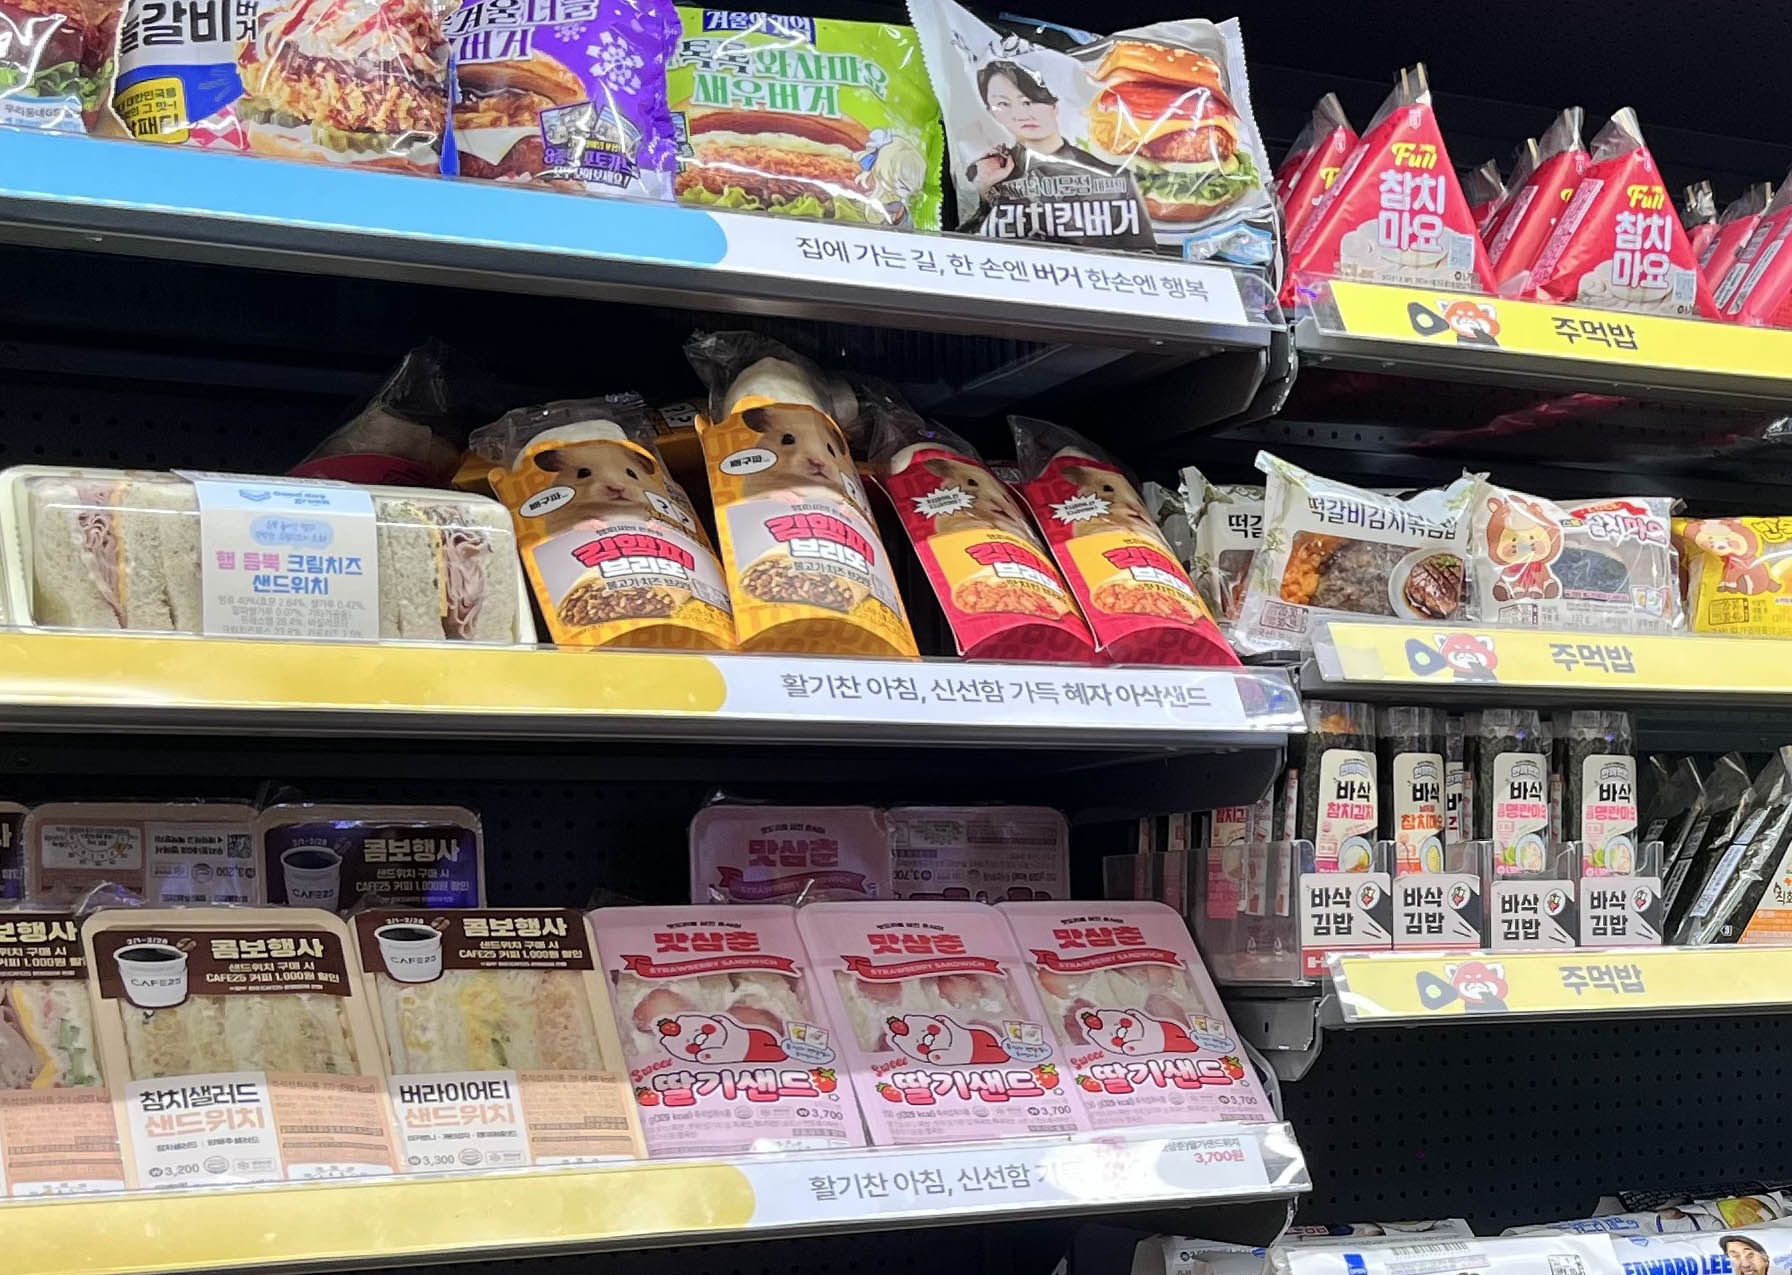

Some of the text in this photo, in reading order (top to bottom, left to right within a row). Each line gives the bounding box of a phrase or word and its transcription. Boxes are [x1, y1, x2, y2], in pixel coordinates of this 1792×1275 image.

[693, 73, 840, 117] 새우버거
[1379, 169, 1445, 216] 참치
[1377, 212, 1443, 254] 마요
[796, 236, 1209, 302] 집에 가는 길, 한 손엔 버거 한손엔 행복
[1552, 316, 1638, 352] 주먹밥
[216, 551, 234, 571] 햄
[286, 553, 363, 576] 크림치즈
[252, 574, 329, 595] 샌드위치
[1549, 642, 1637, 675] 주먹밥
[780, 673, 1211, 709] 활기찬 아침, 신선함 가득 혜자 아삭샌드
[1336, 780, 1371, 803] 바삭
[1311, 887, 1352, 910] 바삭
[1590, 888, 1627, 912] 바삭
[1313, 912, 1354, 937] 김밥
[1590, 913, 1628, 937] 김밥
[211, 938, 324, 960] 콤보행사
[130, 975, 182, 989] CAFE25
[206, 973, 243, 983] CAFE25
[246, 972, 271, 983] 커피
[1559, 962, 1646, 995] 주먹밥
[653, 1069, 818, 1105] 딸기샌드
[1089, 1058, 1226, 1094] 딸기샌드
[139, 1082, 261, 1112] 참치샐러드
[400, 1080, 511, 1104] 버라이어티
[145, 1106, 266, 1137] 샌드위치
[404, 1103, 517, 1130] 샌드위치
[1194, 1150, 1245, 1165] 3,700원
[809, 1163, 1031, 1200] 활기찬 아침, 신선함
[1702, 1254, 1732, 1275] LEE
